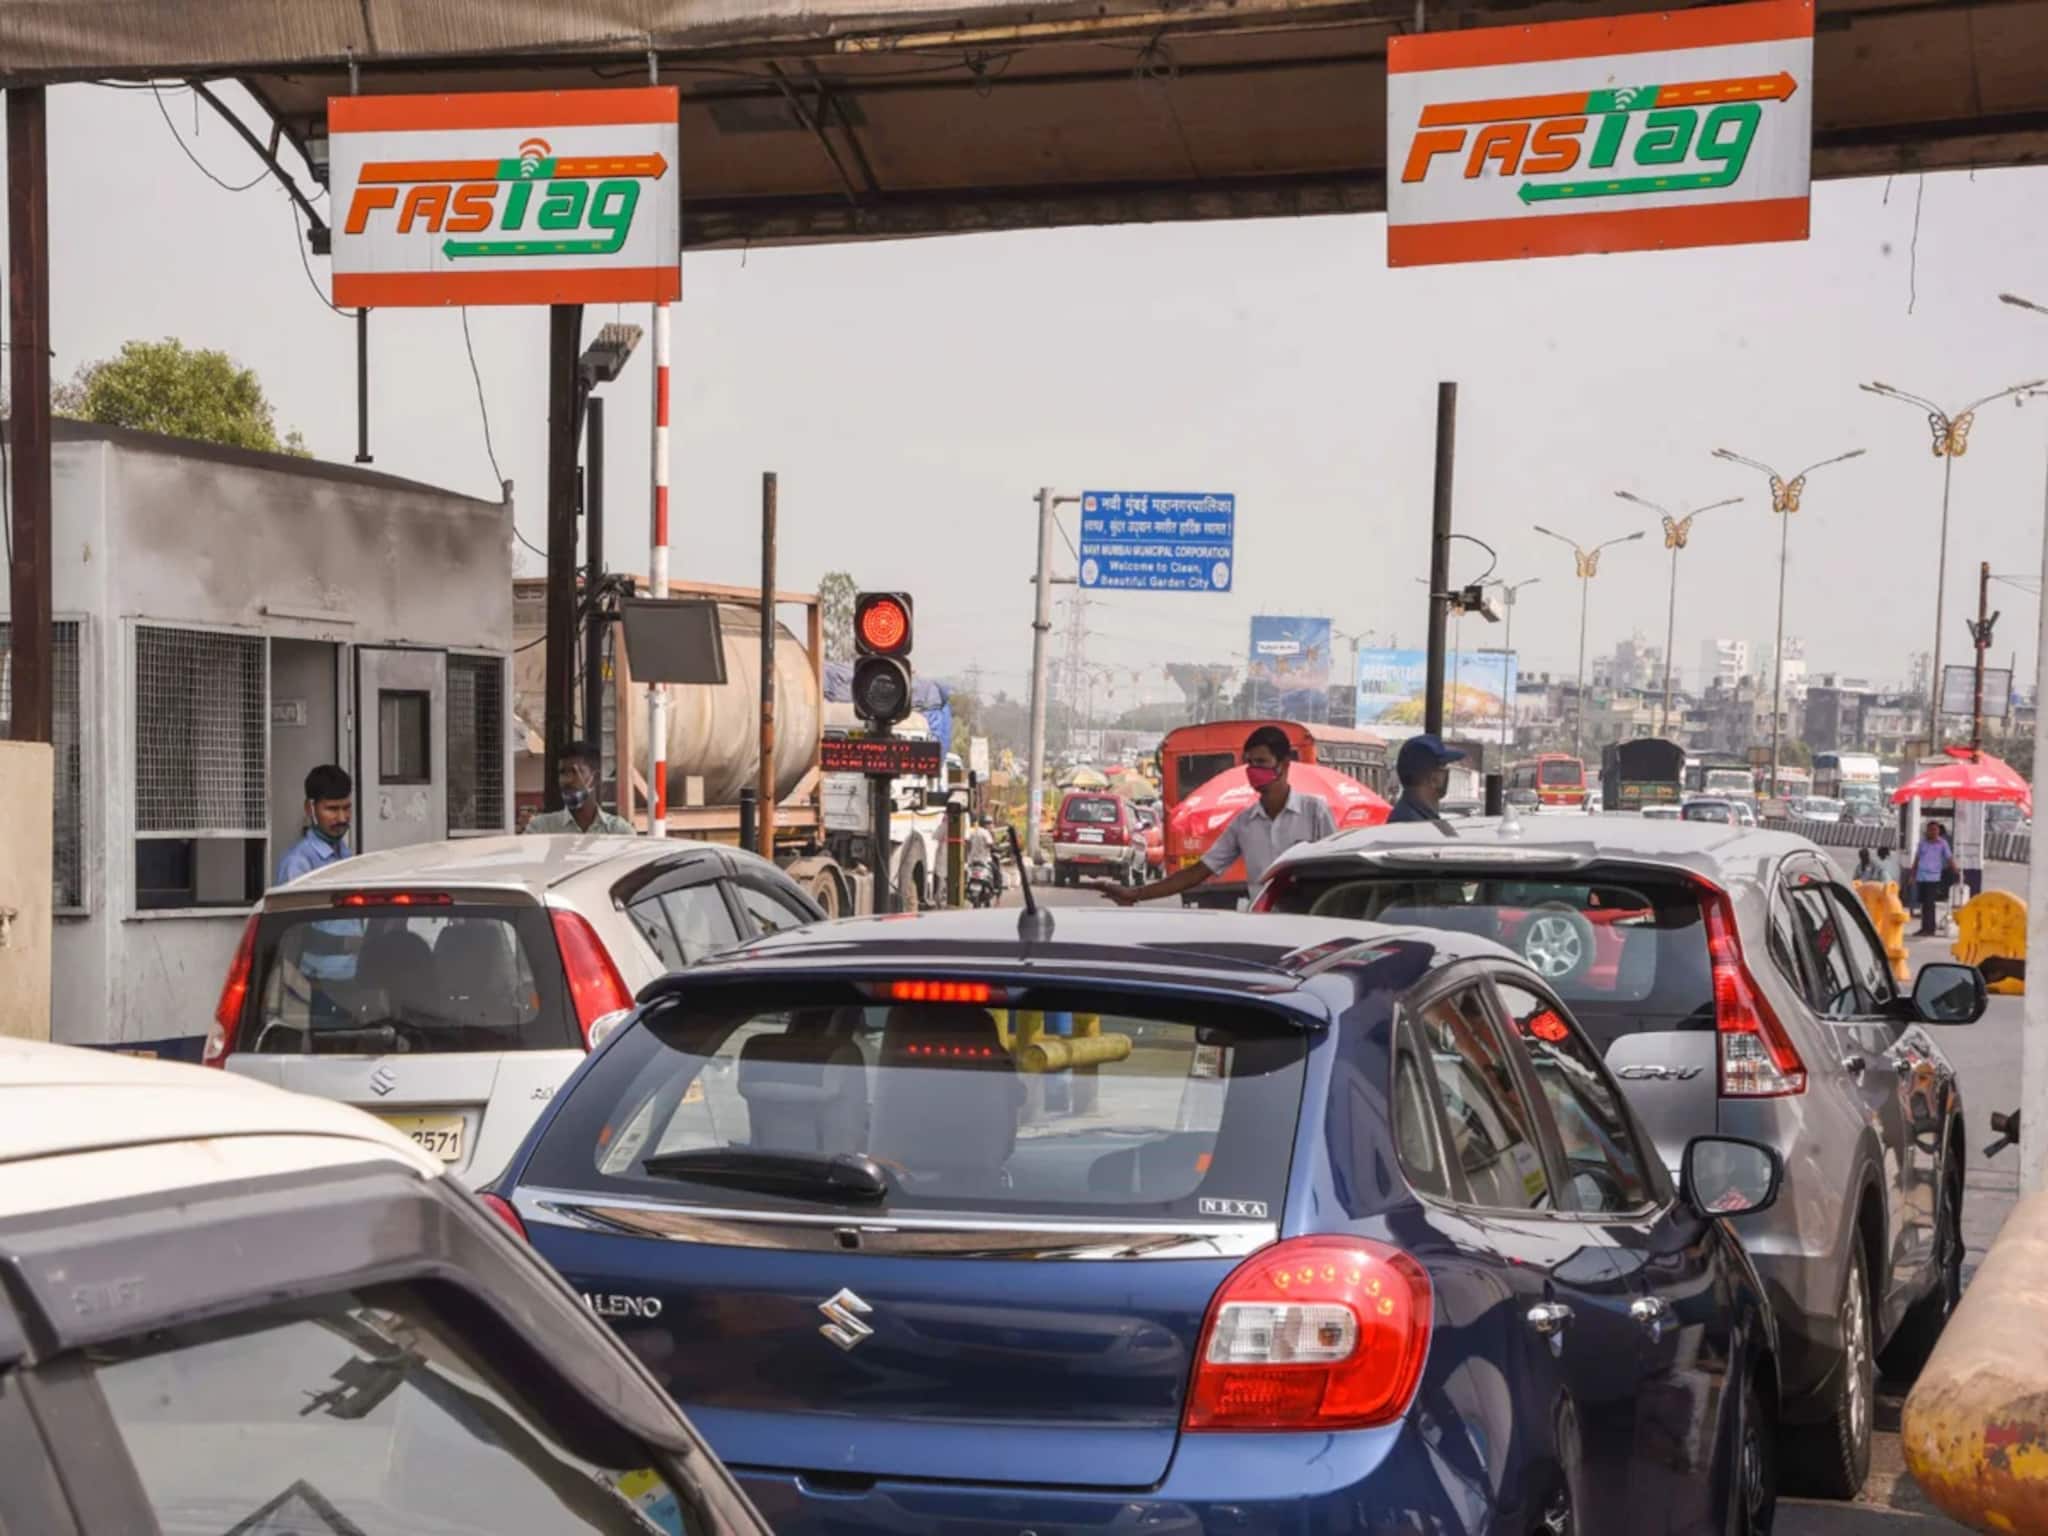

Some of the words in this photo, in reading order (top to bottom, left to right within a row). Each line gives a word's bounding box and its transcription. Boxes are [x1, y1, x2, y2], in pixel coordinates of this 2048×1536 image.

[1401, 86, 1762, 204] FASTag
[343, 157, 641, 257] FASTag
[1175, 546, 1230, 558] CORPORATION
[1109, 560, 1154, 572] Welcome
[1156, 561, 1168, 572] to
[1100, 575, 1147, 587] Beautiful
[1149, 576, 1186, 588] Garden
[1187, 577, 1209, 590] City
[1205, 1200, 1262, 1215] NEXA
